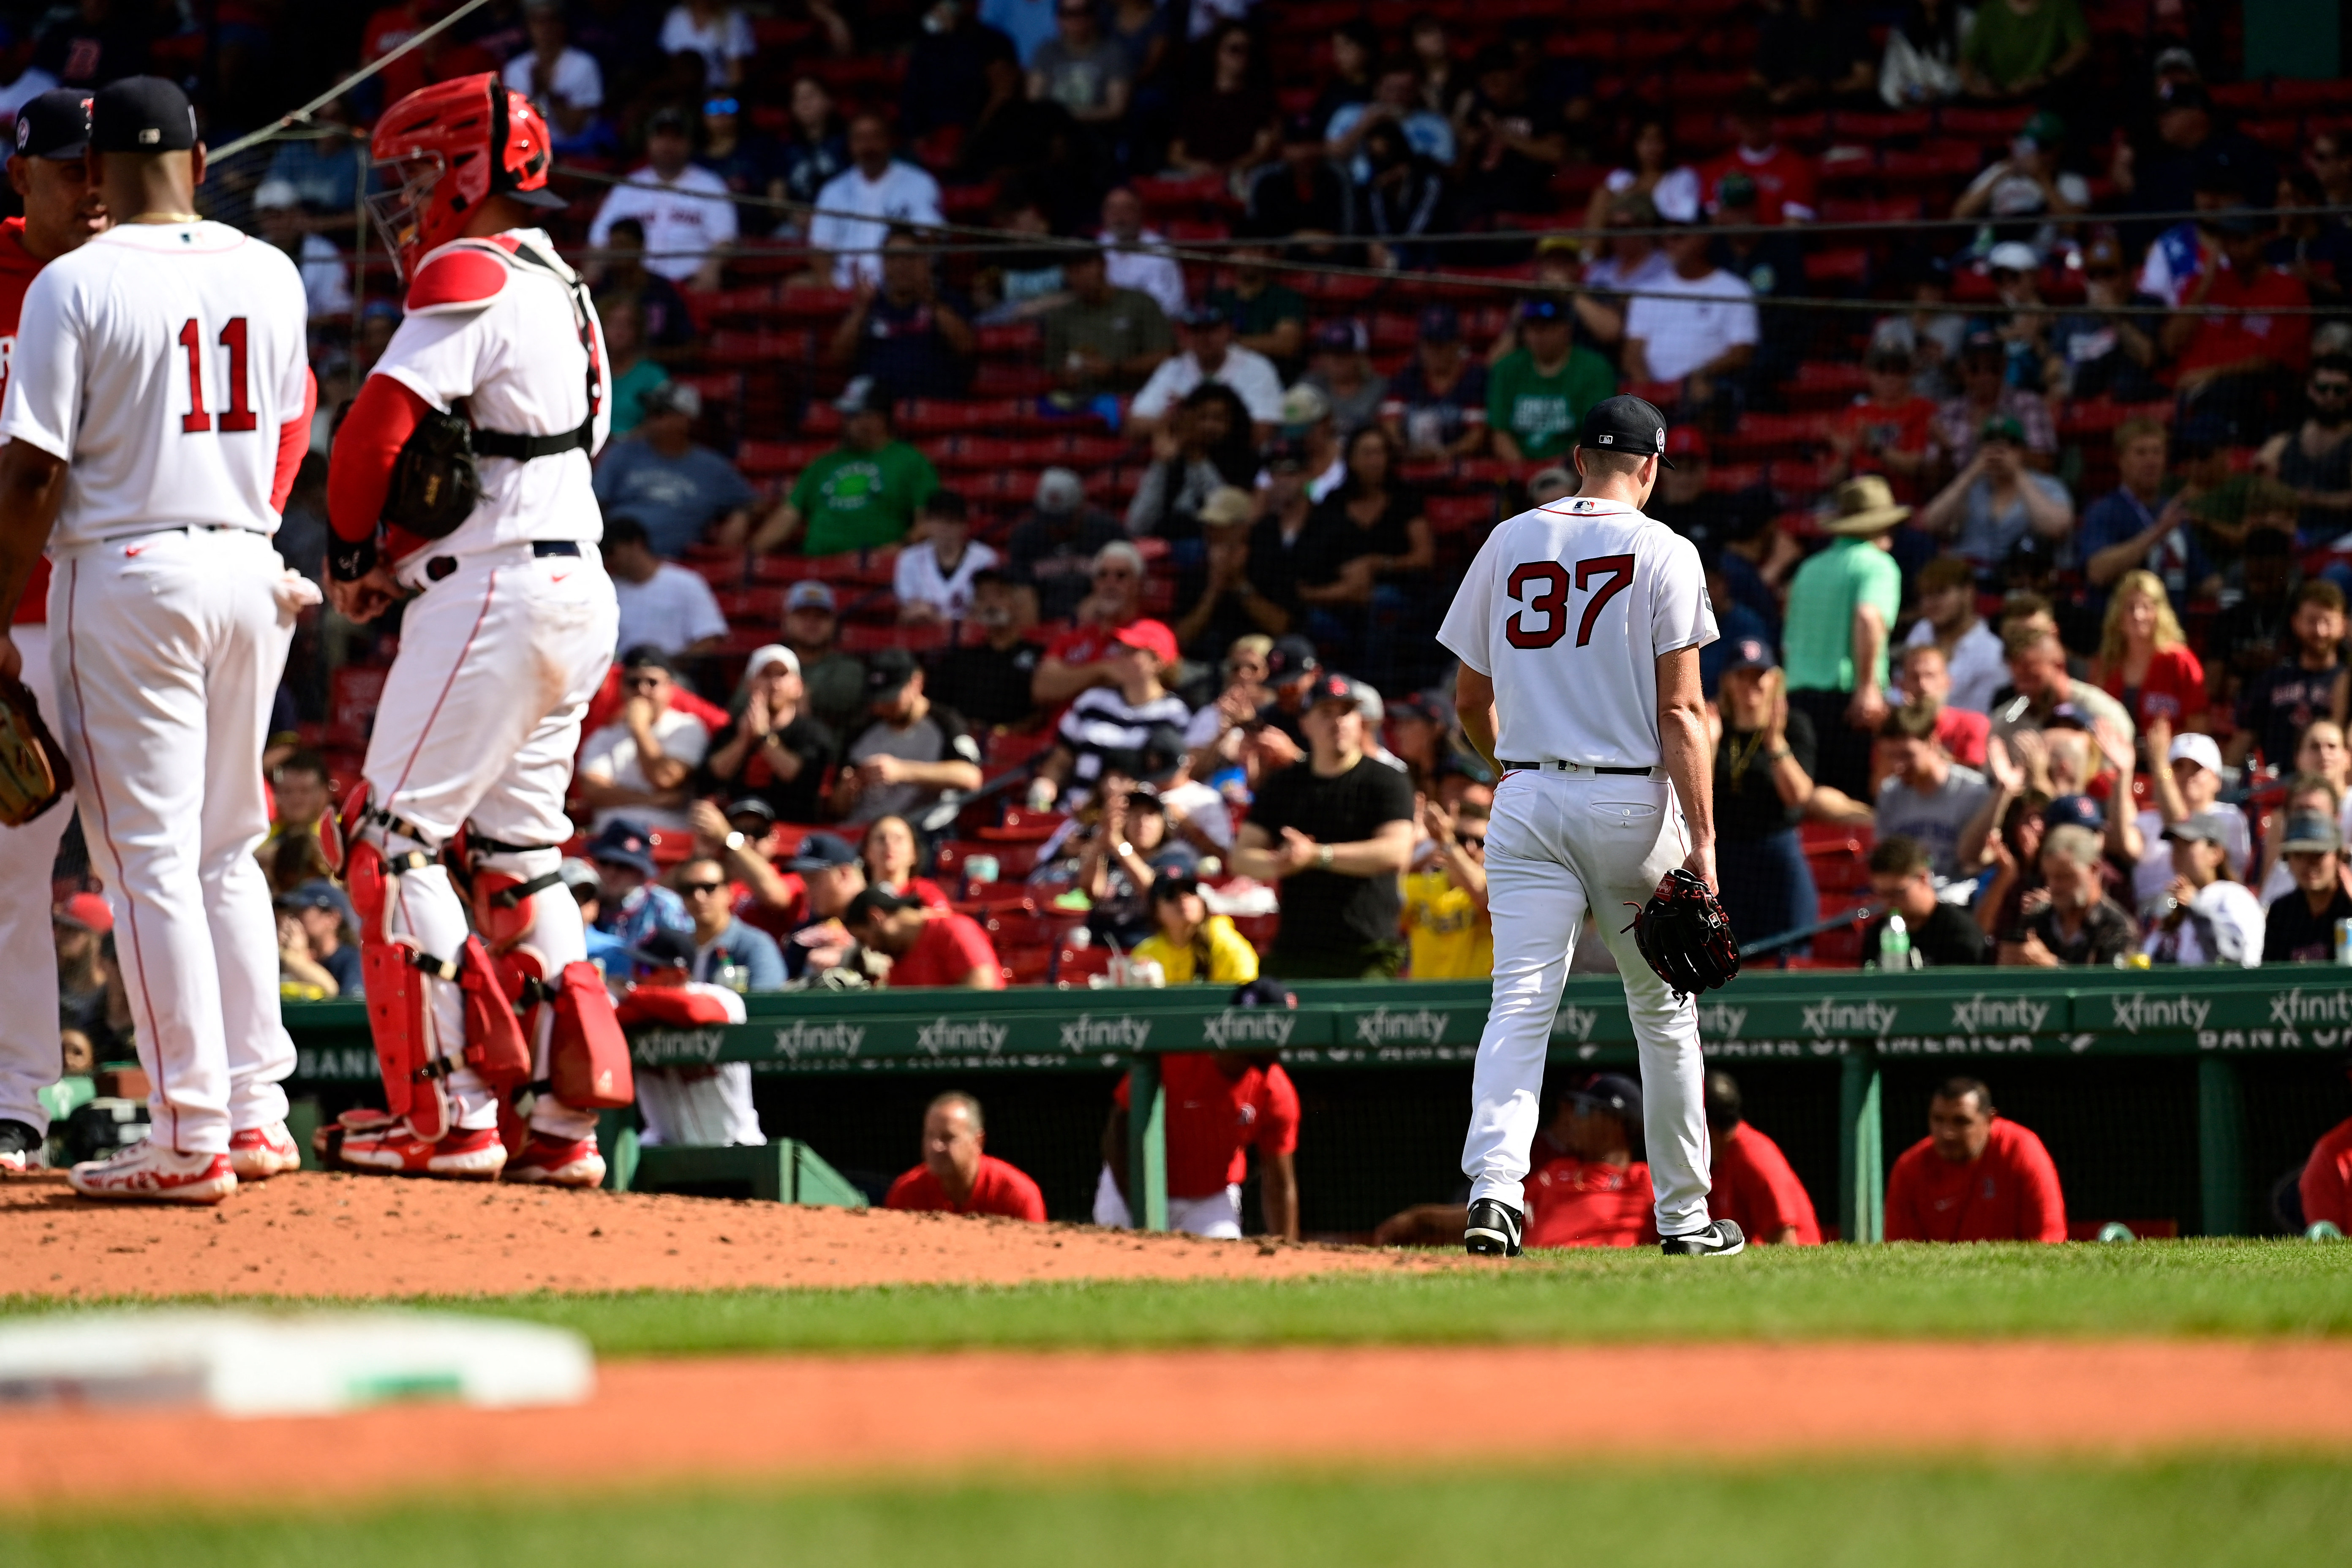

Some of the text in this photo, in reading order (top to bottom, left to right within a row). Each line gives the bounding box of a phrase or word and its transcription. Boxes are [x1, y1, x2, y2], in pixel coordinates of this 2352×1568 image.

[178, 317, 256, 432] 11
[1505, 553, 1636, 650] 37
[1203, 1007, 1296, 1049] xfinity
[1355, 1007, 1449, 1047] xfinity
[1802, 996, 1897, 1037] xfinity
[1951, 992, 2050, 1034] xfinity
[2112, 991, 2211, 1034] xfinity
[2270, 987, 2352, 1031] xfinit
[636, 1026, 722, 1064] xfinity
[774, 1020, 866, 1059] xfinity
[916, 1016, 1010, 1056] xfinity
[1059, 1013, 1152, 1054] xfinity
